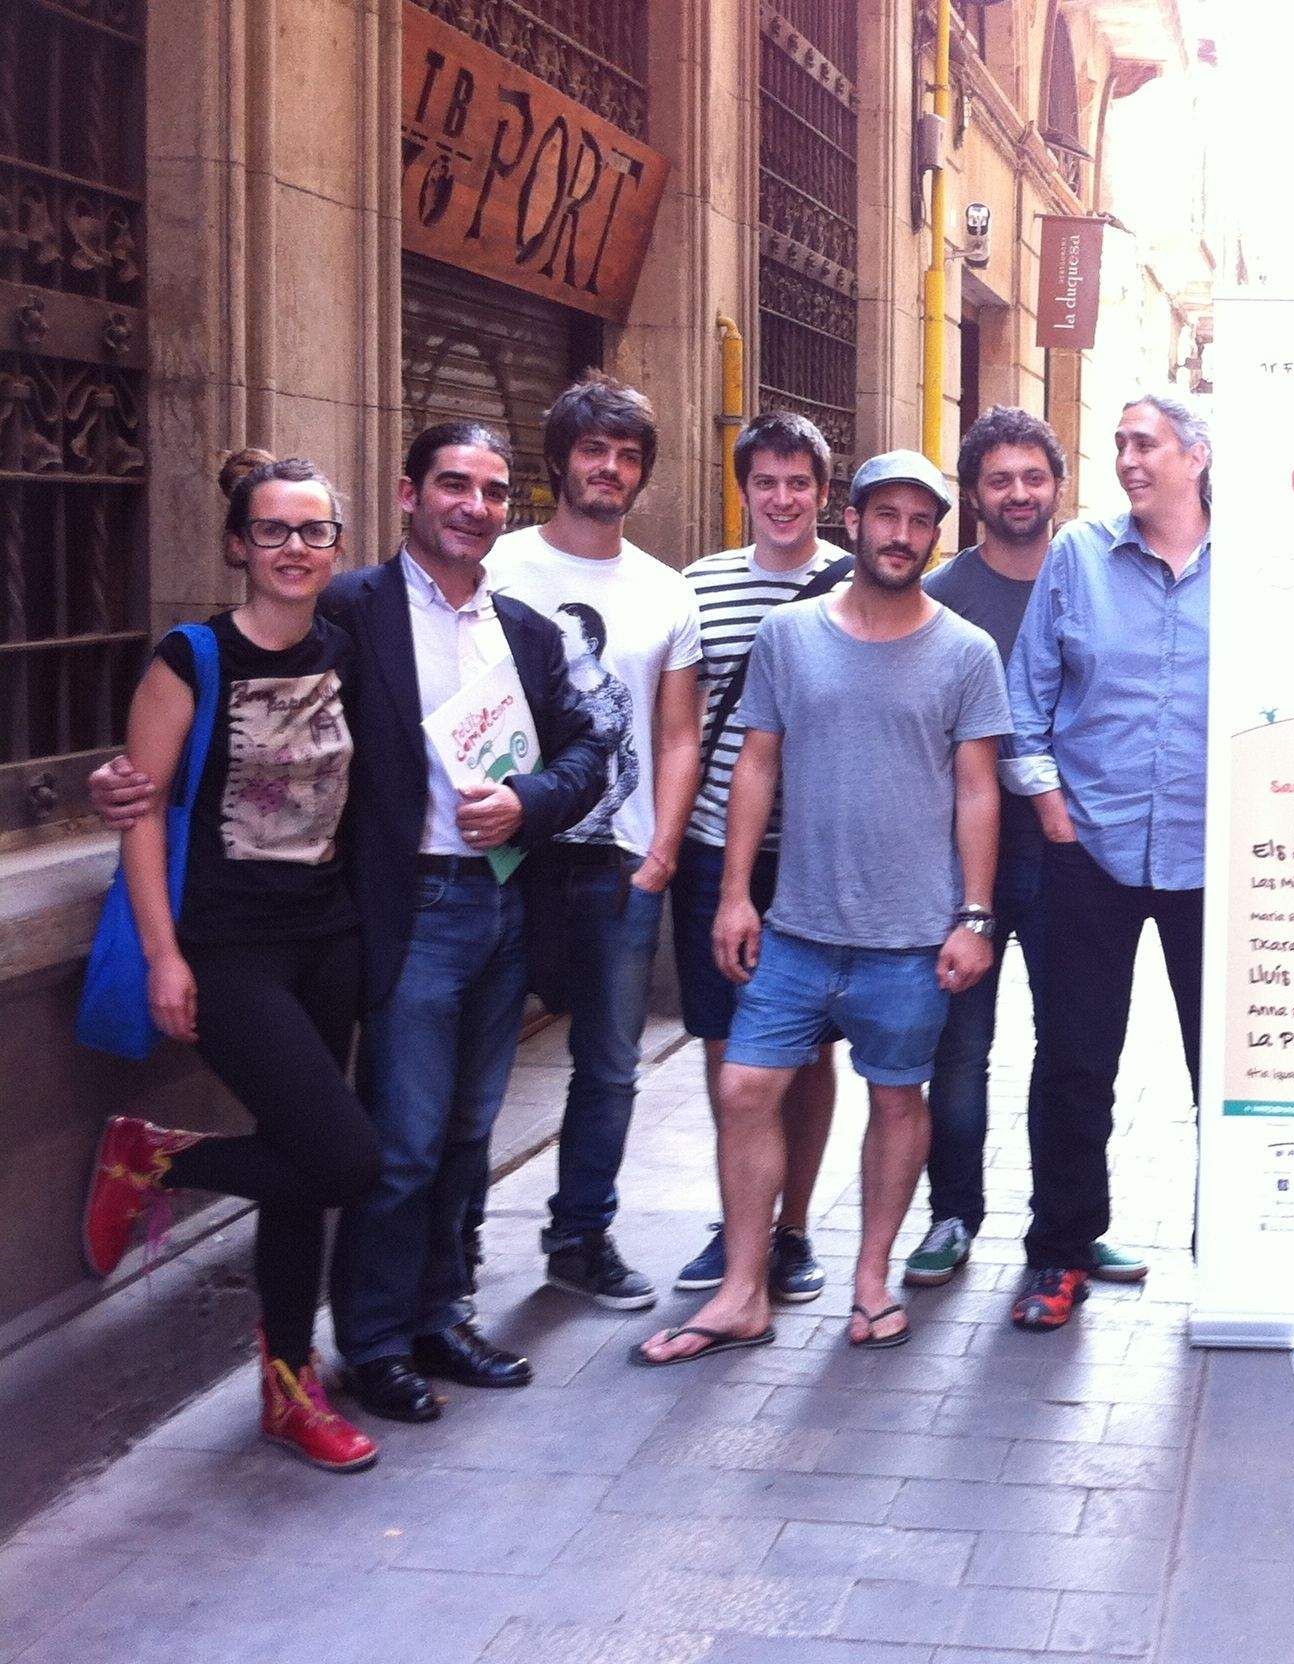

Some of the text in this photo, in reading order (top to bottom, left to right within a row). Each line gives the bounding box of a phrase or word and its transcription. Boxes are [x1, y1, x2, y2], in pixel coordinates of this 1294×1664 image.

[464, 84, 644, 295] PORT
[1053, 234, 1083, 329] la duquesa
[1252, 839, 1286, 861] Els
[1251, 876, 1277, 891] Las
[1249, 963, 1290, 987] Lluís
[1248, 1003, 1288, 1018] Anna
[1246, 1031, 1274, 1049] La
